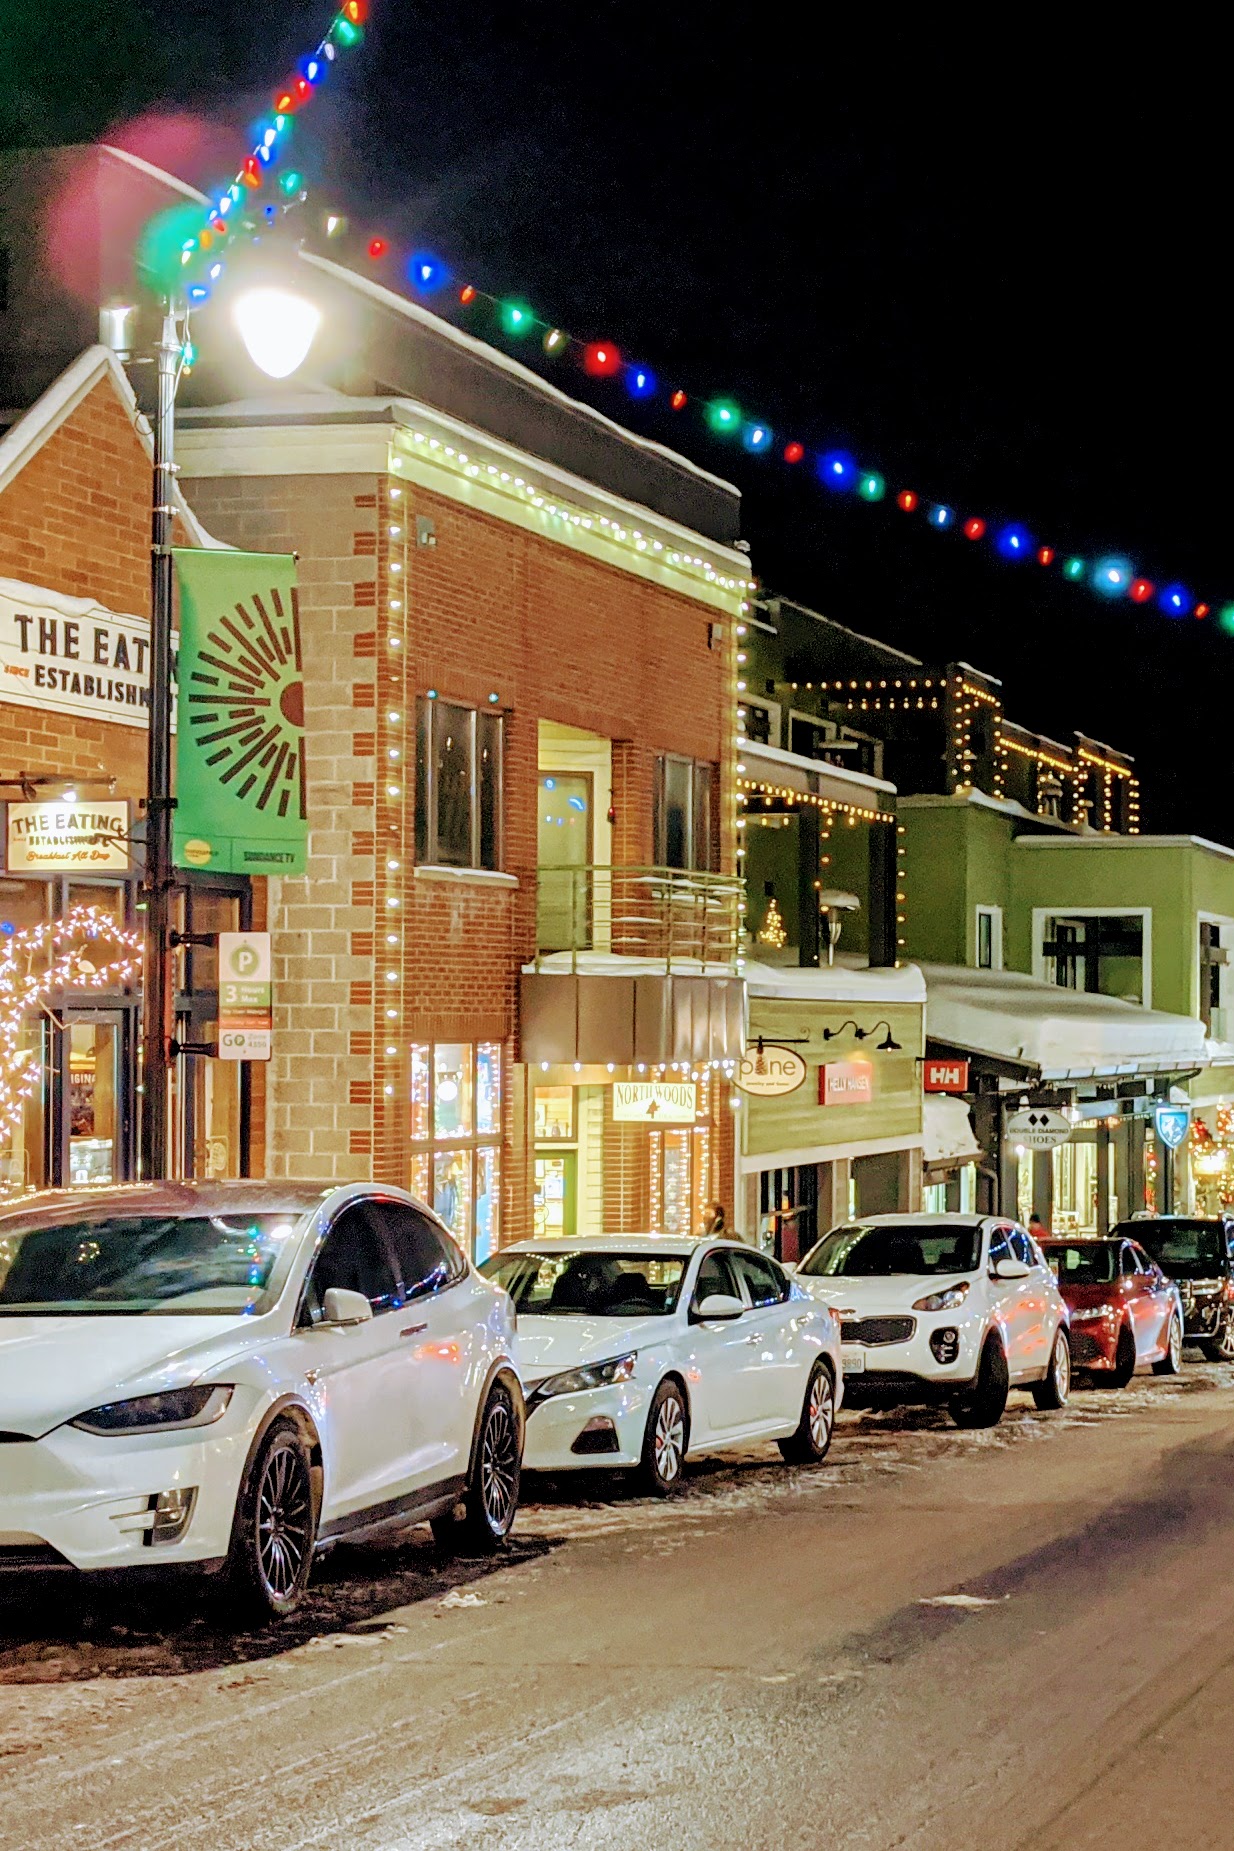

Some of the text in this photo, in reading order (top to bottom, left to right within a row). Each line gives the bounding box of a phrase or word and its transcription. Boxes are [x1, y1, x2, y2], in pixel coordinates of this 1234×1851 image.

[14, 614, 80, 660] THE
[12, 813, 123, 834] THE EATING
[26, 850, 69, 861] Breakfast
[71, 850, 88, 861] All
[239, 951, 253, 972] P
[226, 985, 237, 1003] 3
[241, 995, 258, 1003] Max
[930, 1066, 960, 1084] HH
[1023, 1135, 1057, 1144] SHOES
